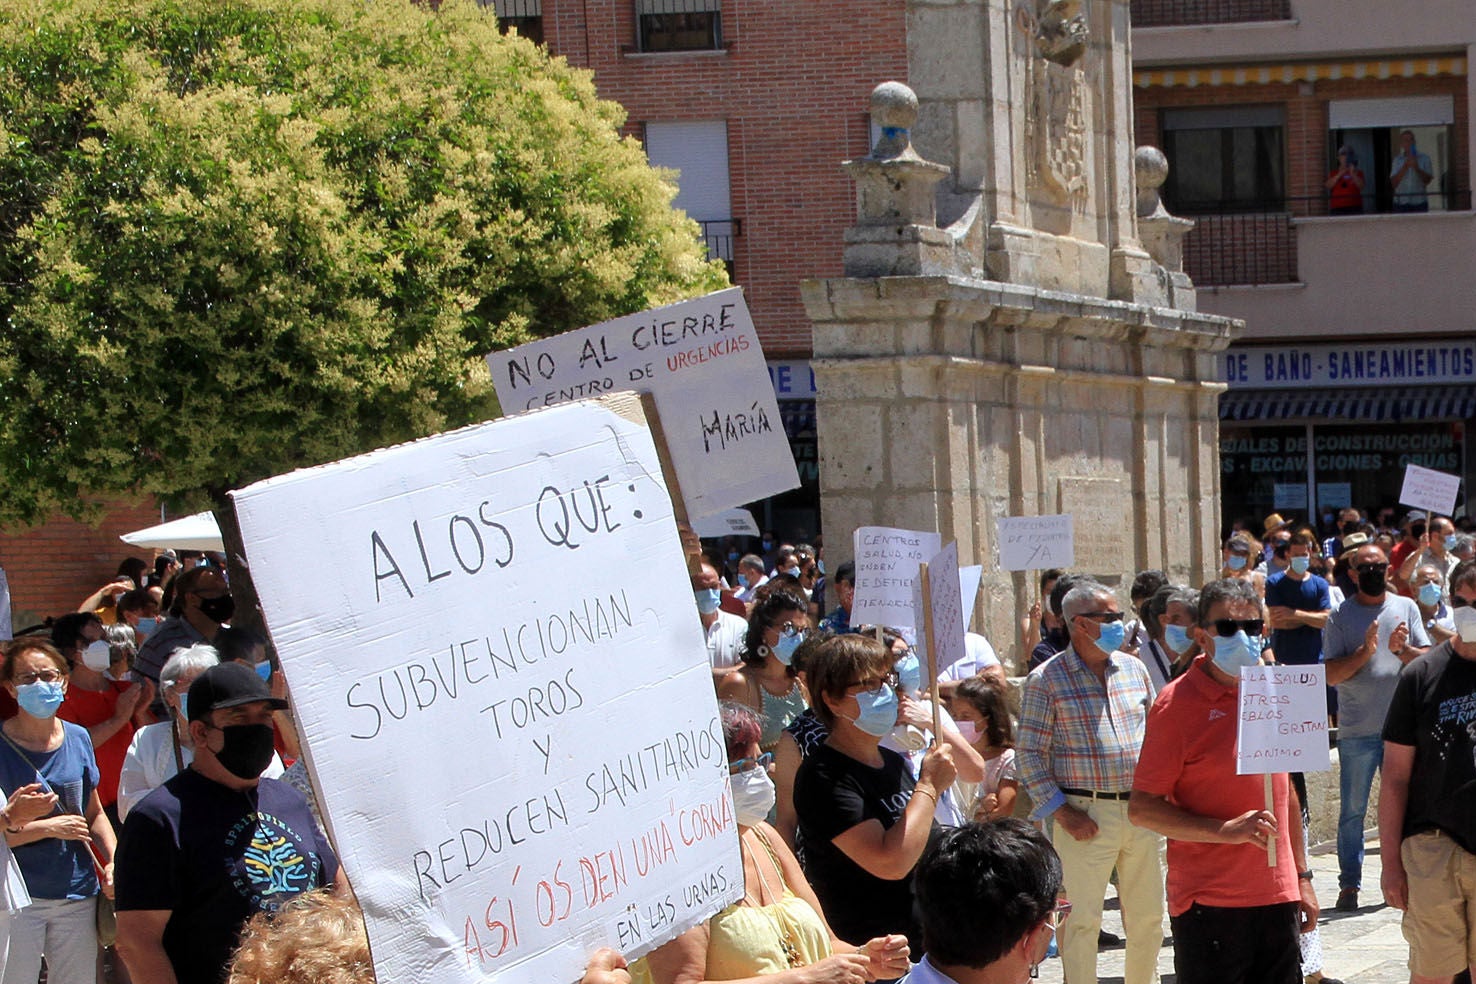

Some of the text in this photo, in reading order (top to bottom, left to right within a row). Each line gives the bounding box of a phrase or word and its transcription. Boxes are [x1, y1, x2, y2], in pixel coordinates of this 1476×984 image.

[507, 303, 736, 389] NO AL CIERRE
[526, 334, 750, 411] CENTRO DE URGENCIAS
[1226, 347, 1474, 382] DE BAÑO SANEAMIENTOS
[700, 401, 772, 453] MARÍA
[863, 534, 920, 546] CENTROS
[346, 588, 633, 739] SUBVENCIONAN
[1271, 673, 1318, 687] SALUD
[480, 668, 583, 739] TOROS
[1278, 721, 1326, 735] GRITAN
[532, 734, 551, 775] Y
[413, 788, 569, 900] REDUCEN
[464, 865, 522, 969] ASÍ
[536, 859, 572, 927] OS
[579, 840, 628, 909] DEN
[632, 819, 679, 878] UNA
[618, 912, 641, 951] EN
[649, 895, 676, 931] LAS
